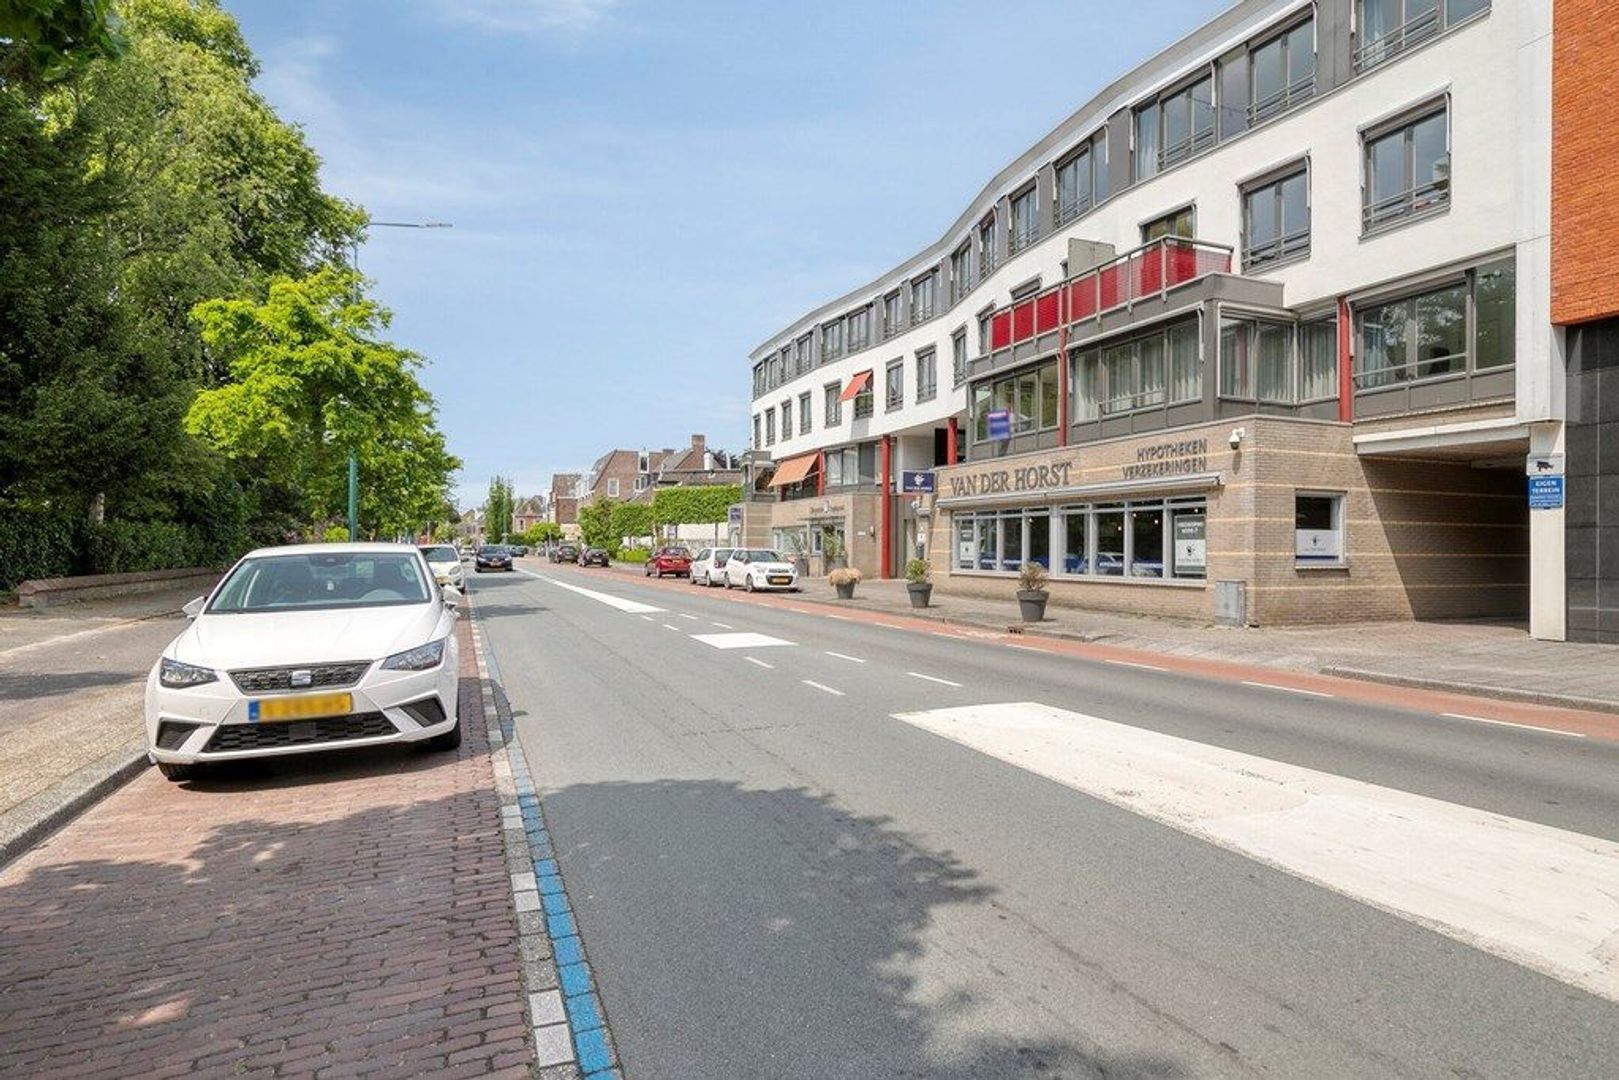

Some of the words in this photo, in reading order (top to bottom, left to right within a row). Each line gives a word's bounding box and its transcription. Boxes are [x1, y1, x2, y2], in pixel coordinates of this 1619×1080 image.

[1137, 439, 1207, 462] HYPOTHEKEN
[950, 475, 977, 497] VAN
[981, 470, 1010, 493] DER
[1015, 461, 1072, 491] HORST
[1122, 457, 1207, 480] VERZEKERINGEN
